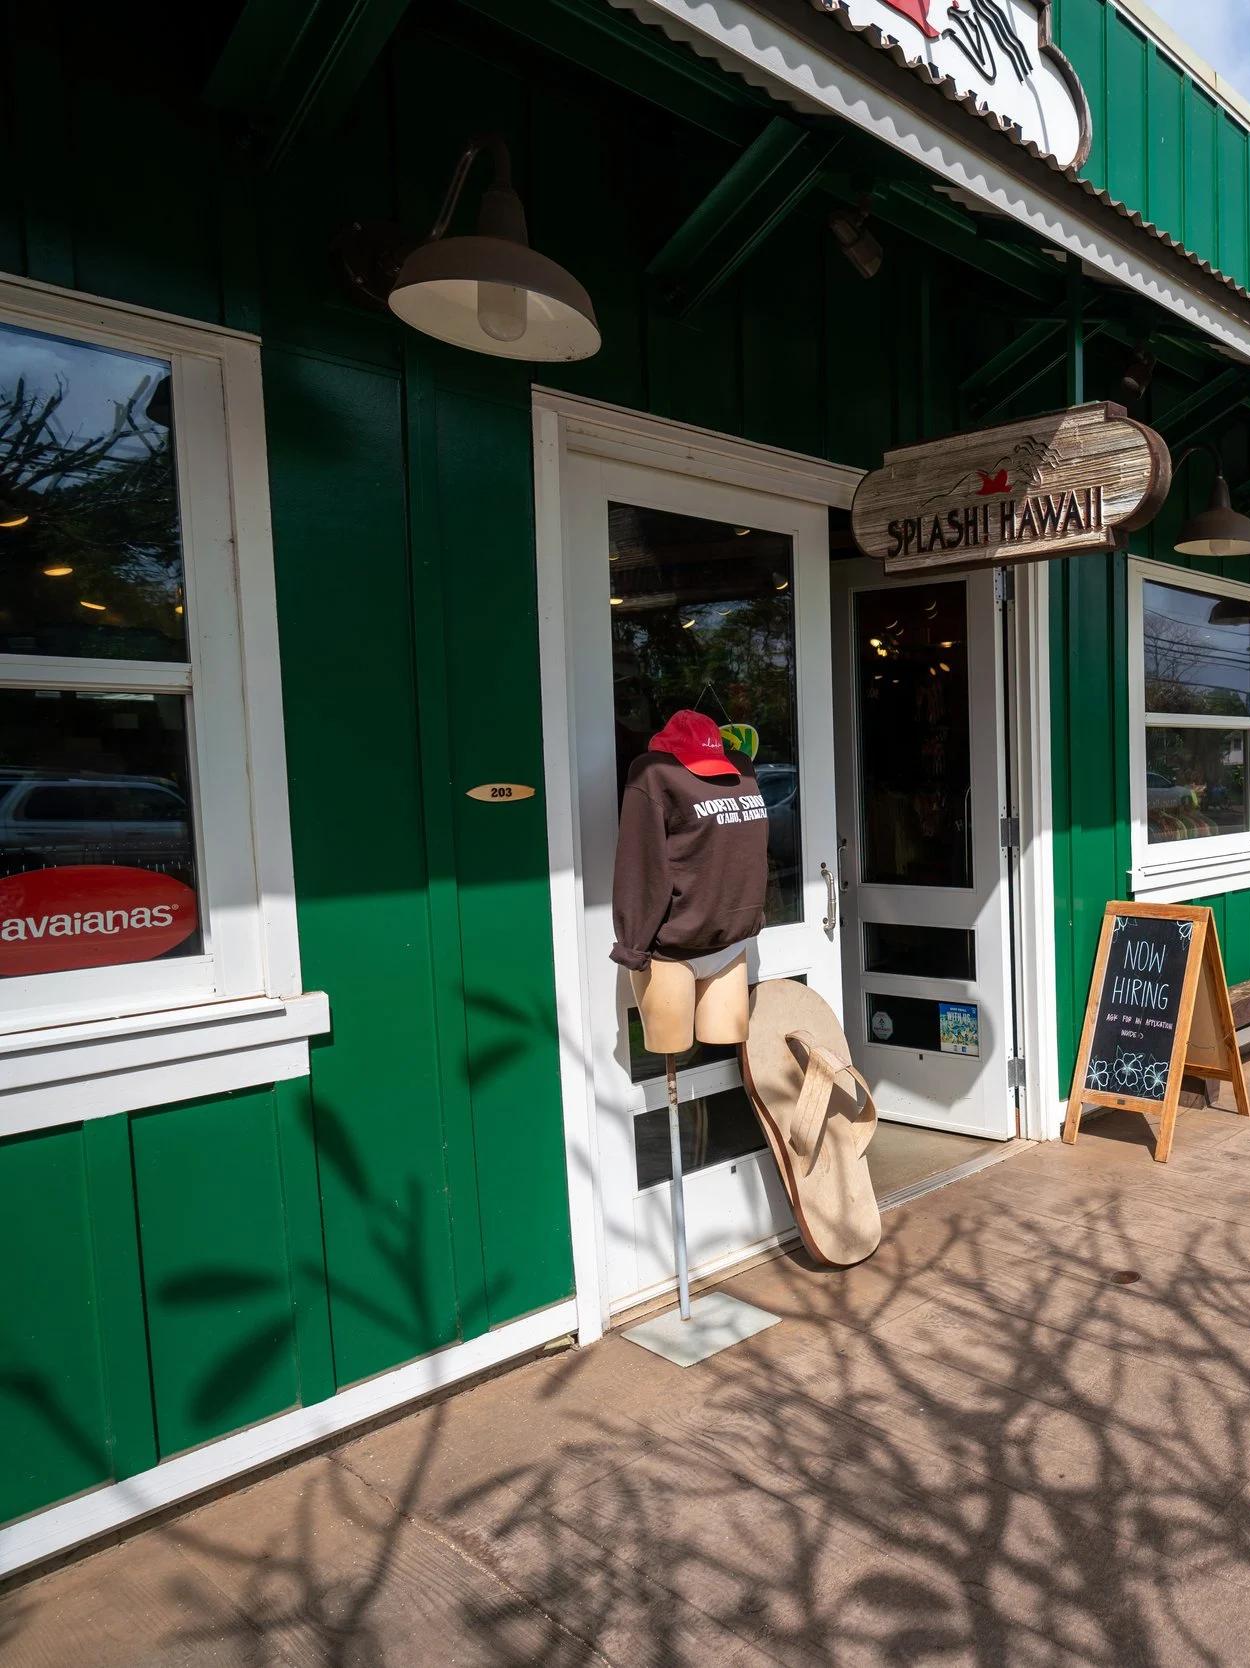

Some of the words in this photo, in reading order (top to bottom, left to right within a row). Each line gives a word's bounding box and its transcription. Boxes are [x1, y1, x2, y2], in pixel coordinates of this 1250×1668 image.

[887, 503, 990, 557] SPLASH!
[1000, 486, 1104, 542] HAWAII
[491, 787, 512, 798] 203
[693, 798, 740, 818] NORTH
[738, 795, 765, 809] SHO
[0, 904, 174, 942] avaianas
[1124, 940, 1166, 973] NOW
[1112, 976, 1170, 1010] HIRING
[1122, 1015, 1132, 1023] FOR
